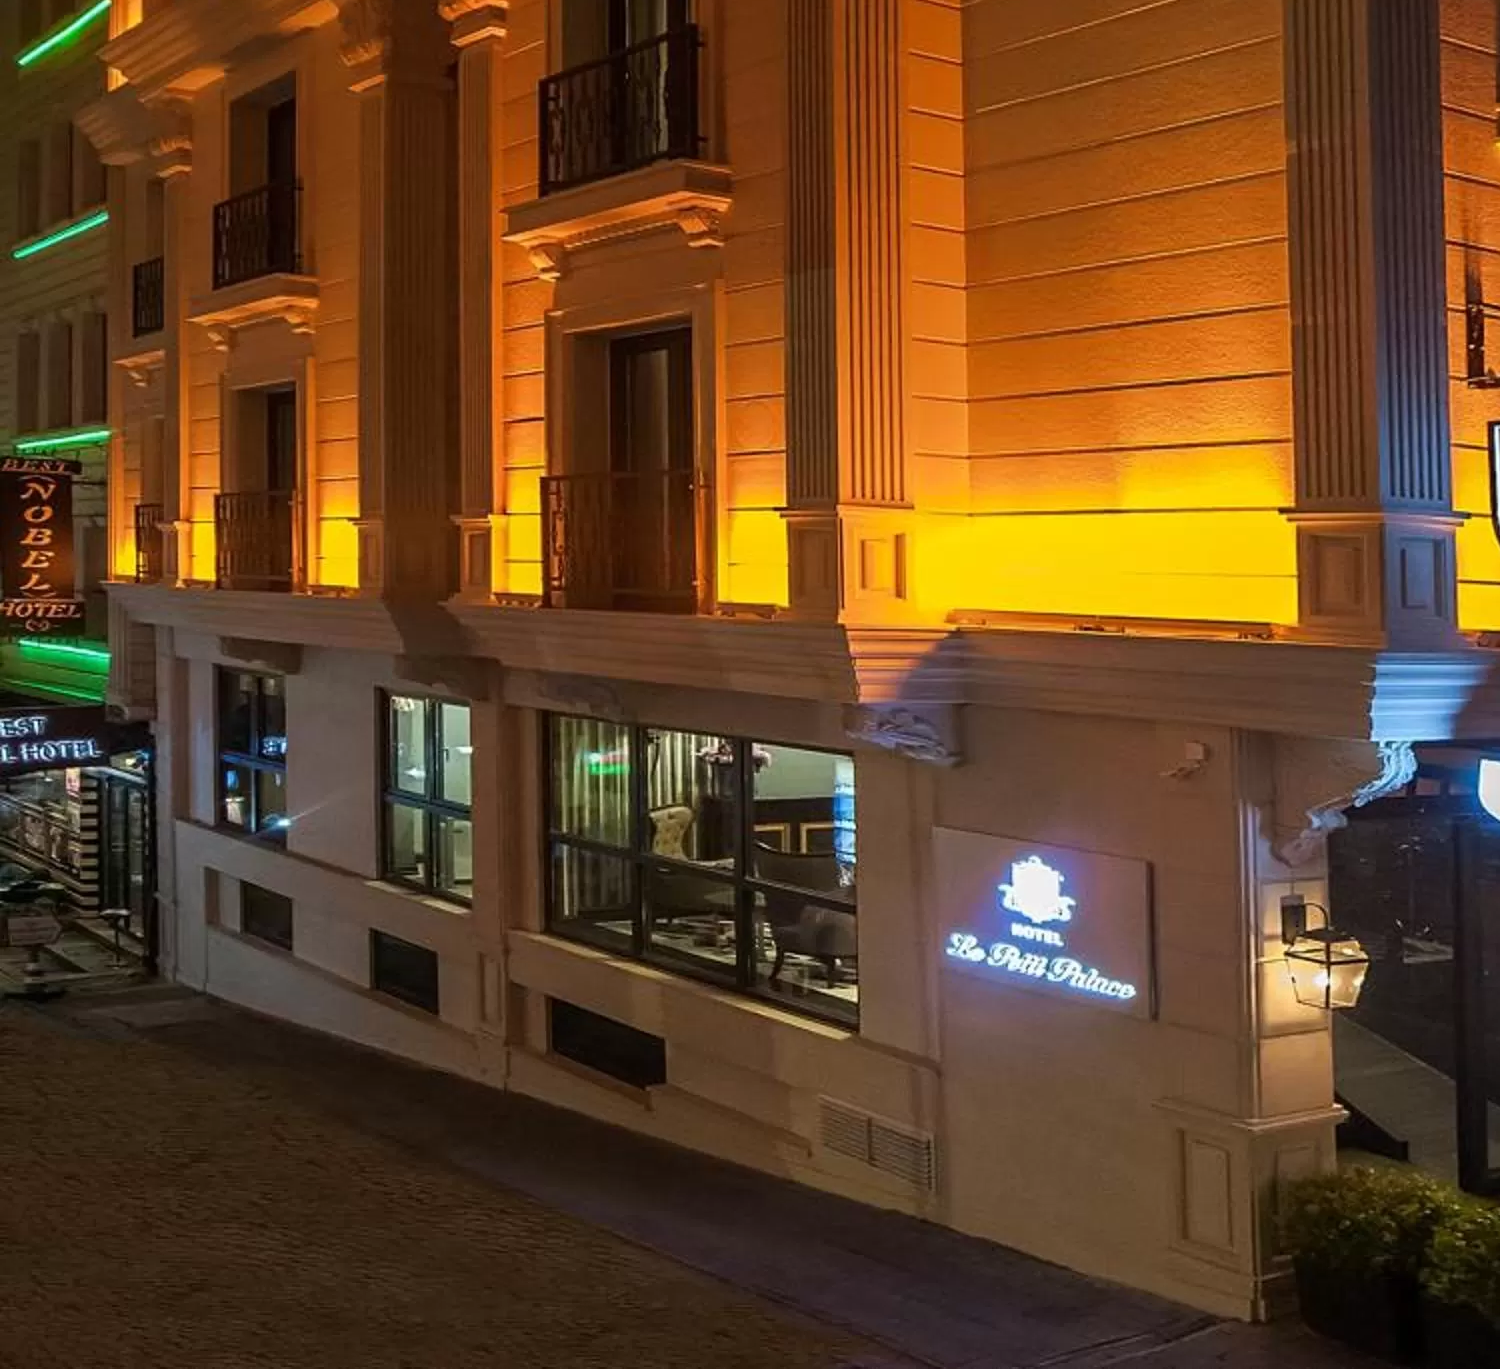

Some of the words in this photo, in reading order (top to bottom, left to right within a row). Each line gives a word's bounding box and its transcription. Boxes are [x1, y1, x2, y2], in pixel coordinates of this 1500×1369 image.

[20, 482, 56, 590] NOBEL
[0, 602, 81, 618] HOTEL
[0, 717, 47, 737] EST
[20, 738, 103, 762] HOTEL
[946, 933, 986, 962] Le
[986, 942, 1049, 978] Petit
[1047, 957, 1137, 1000] Palace
